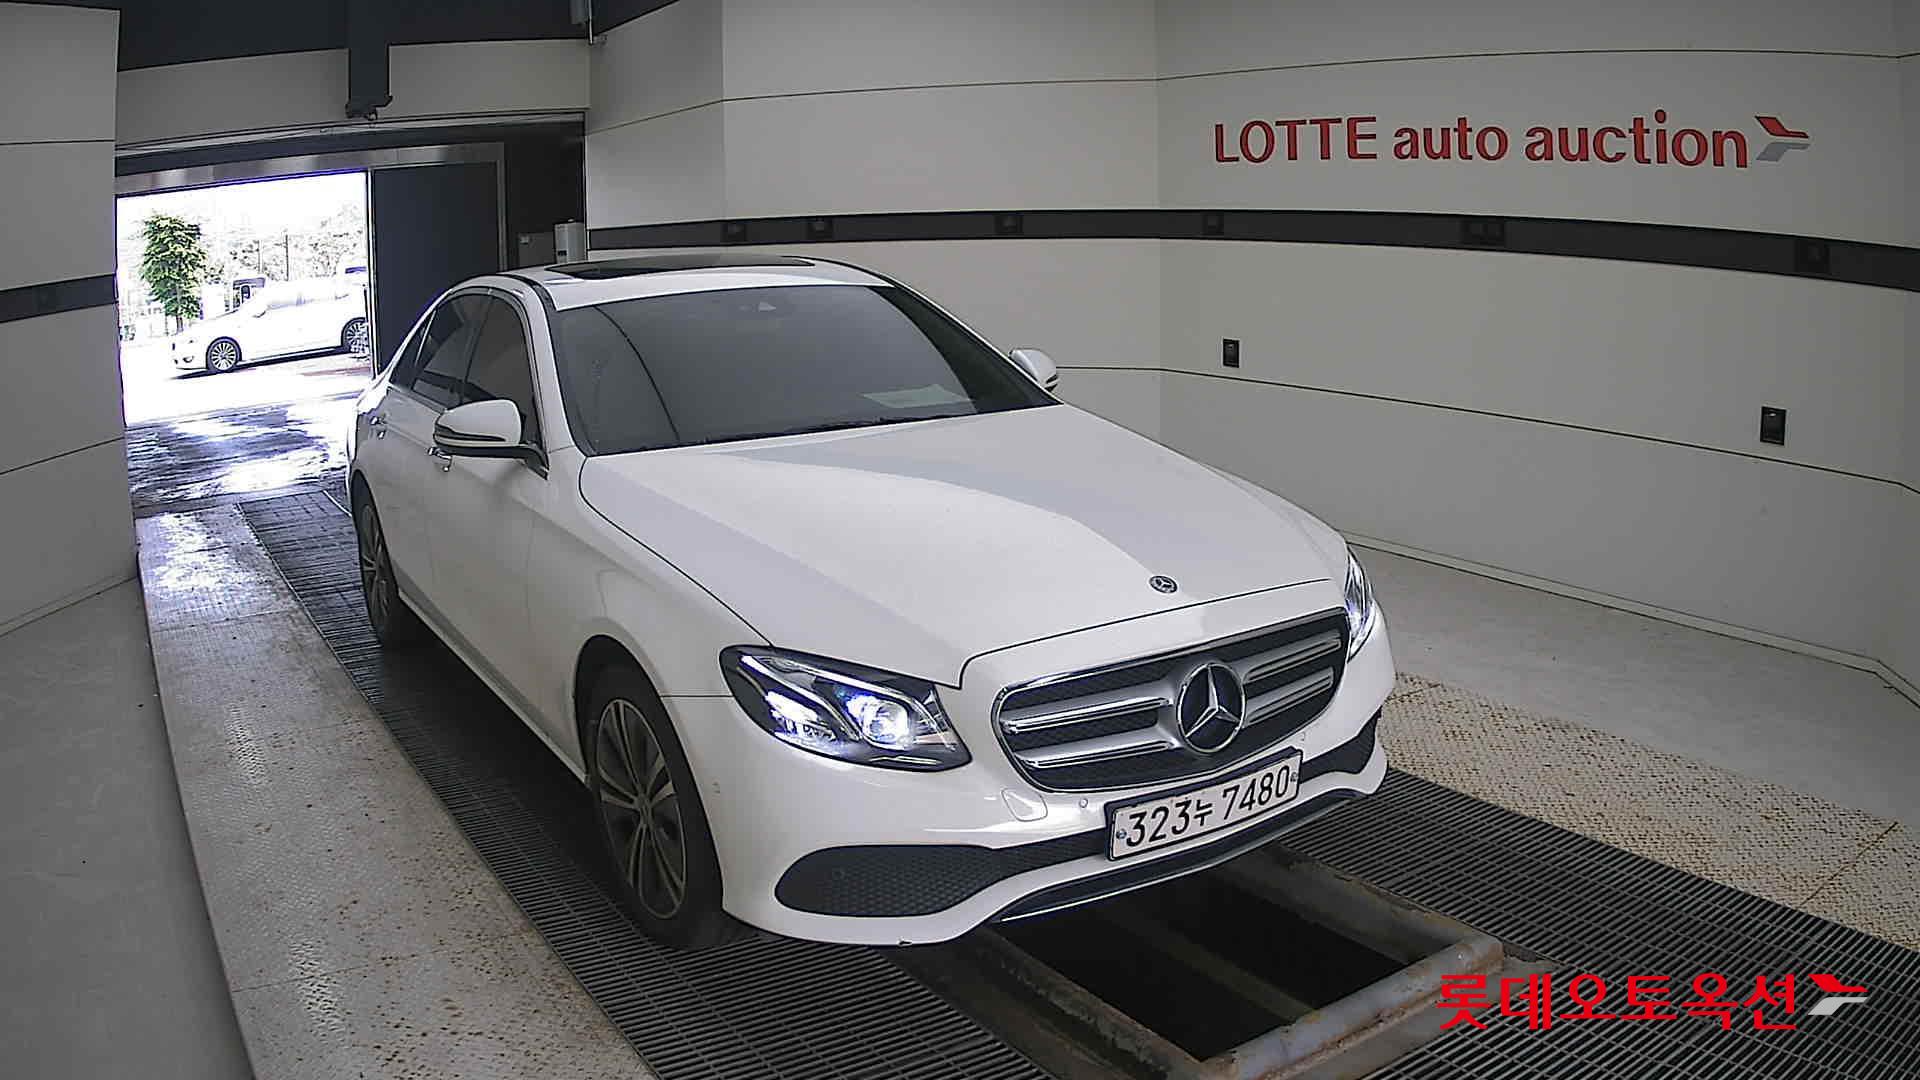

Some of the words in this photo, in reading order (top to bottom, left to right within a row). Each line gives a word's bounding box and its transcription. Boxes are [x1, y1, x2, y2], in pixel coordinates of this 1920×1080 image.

[1214, 116, 1377, 163] LOTTE
[1392, 117, 1509, 162] auto
[1524, 110, 1748, 168] auction
[1126, 799, 1213, 847] 323누
[1222, 765, 1290, 820] 7480
